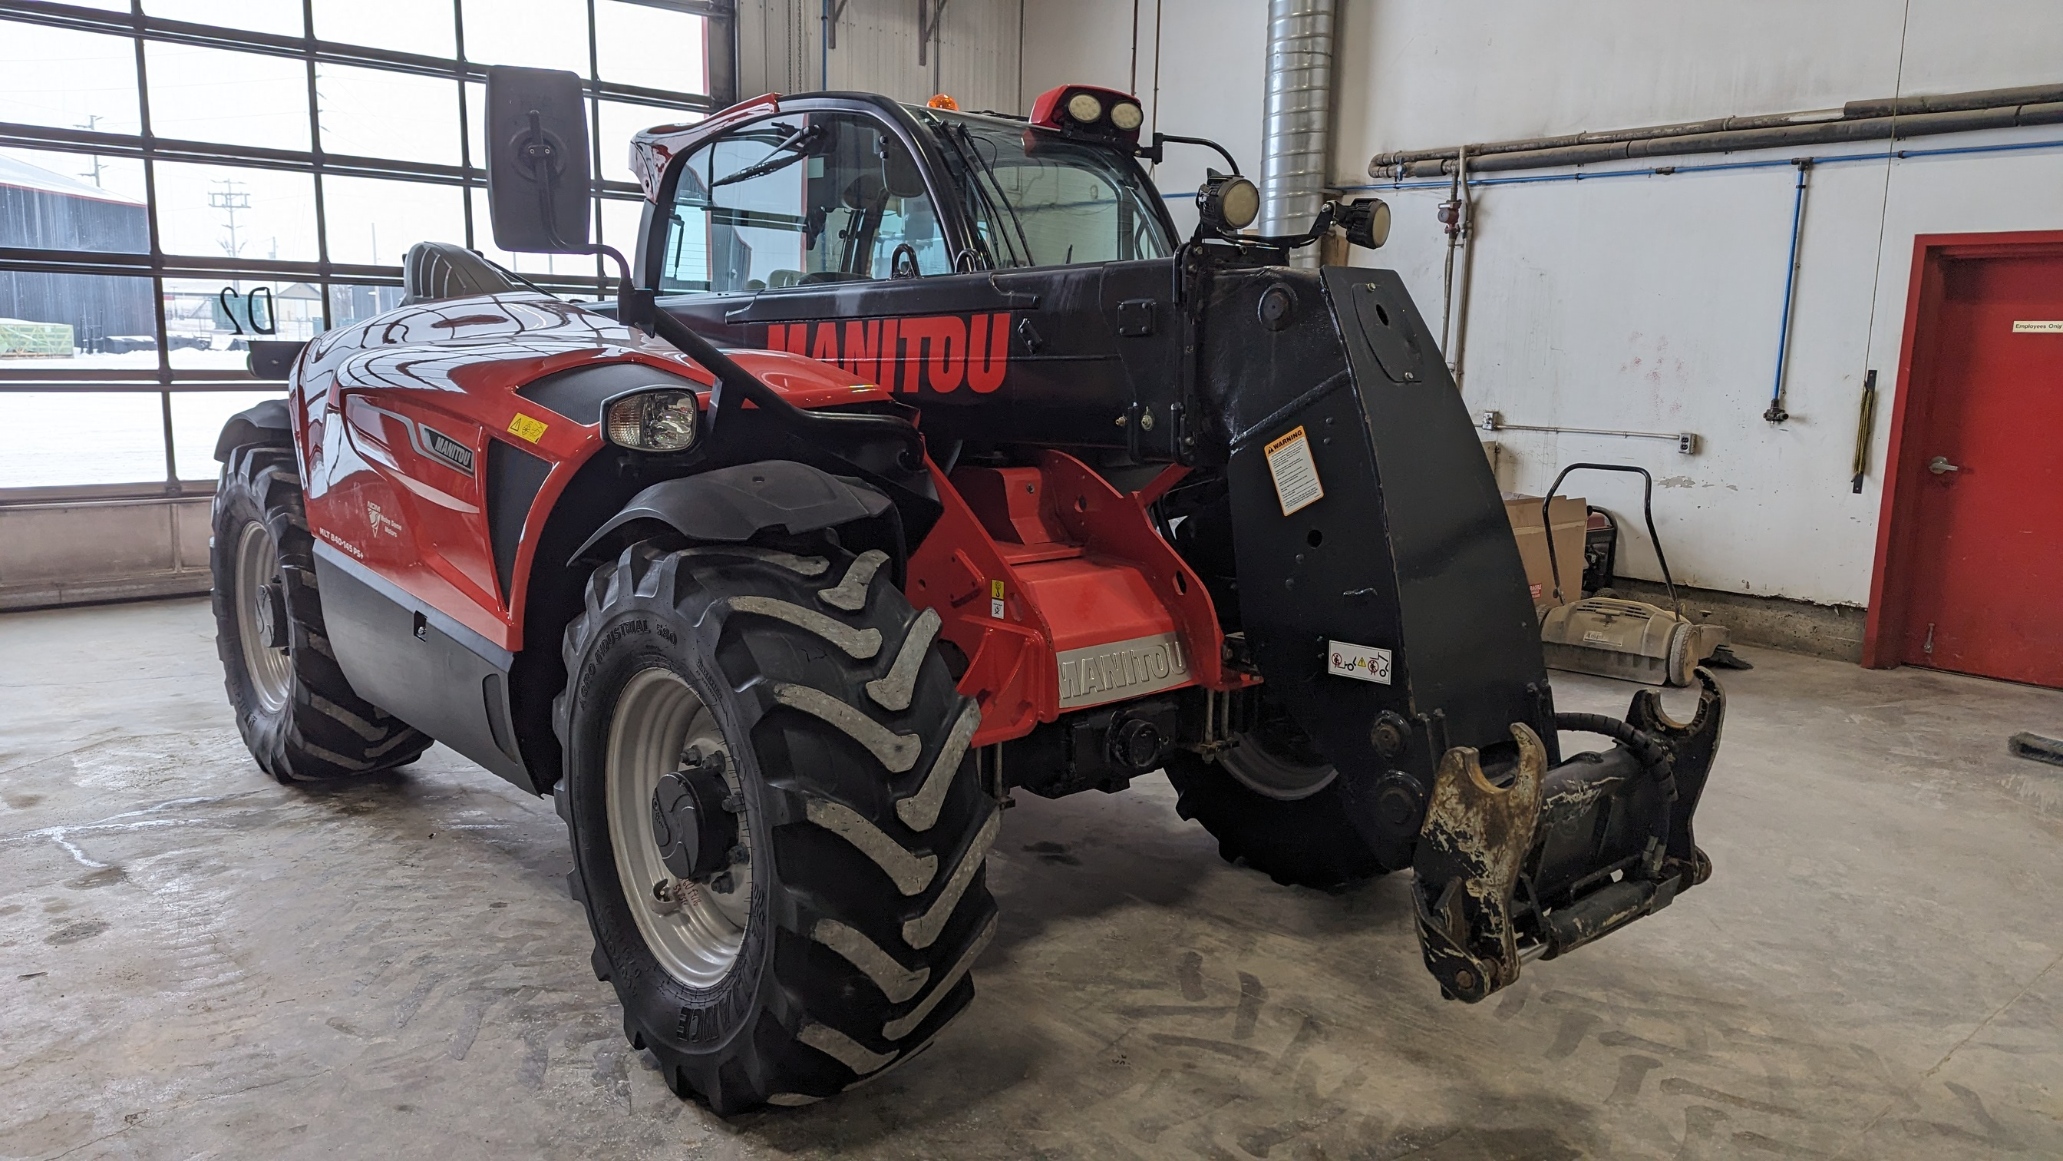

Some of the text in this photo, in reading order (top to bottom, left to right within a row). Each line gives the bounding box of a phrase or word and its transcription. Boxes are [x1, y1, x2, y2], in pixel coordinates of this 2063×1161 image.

[434, 436, 472, 466] MANITOU
[1273, 429, 1303, 450] WARNING
[320, 528, 330, 539] MLT
[1059, 641, 1187, 700] MANITOU
